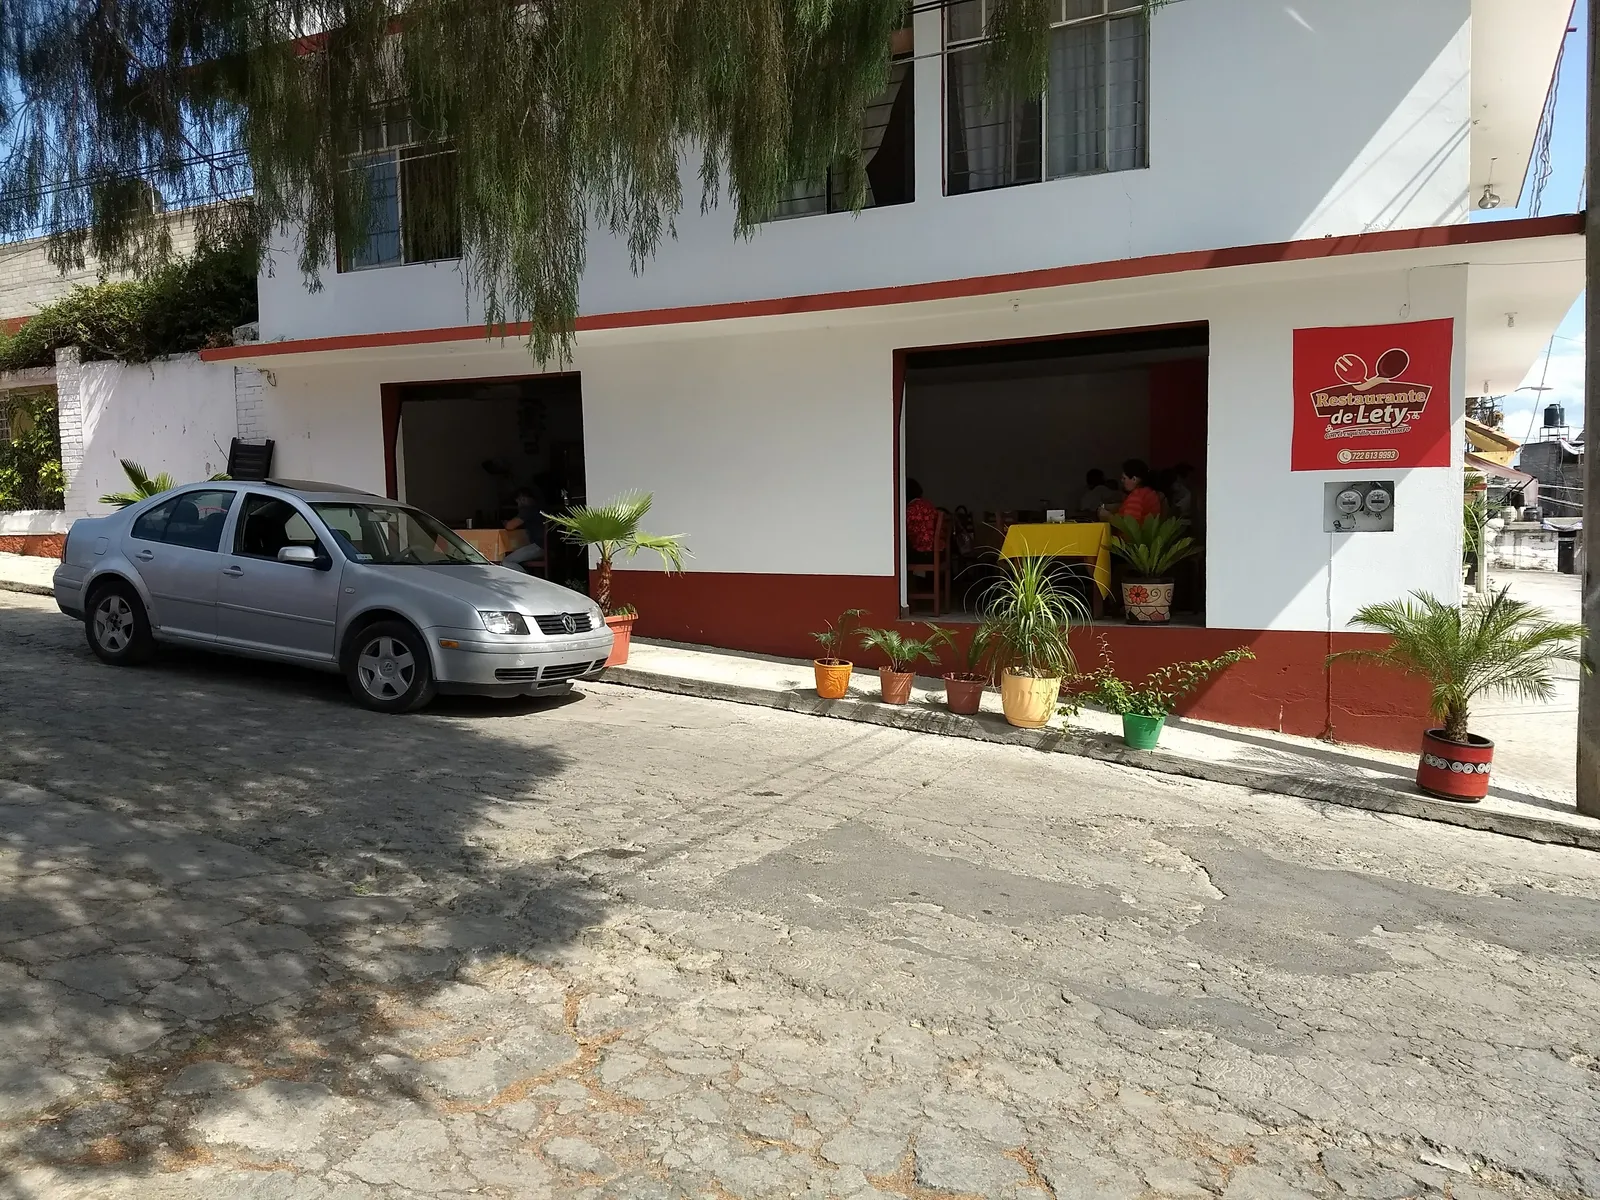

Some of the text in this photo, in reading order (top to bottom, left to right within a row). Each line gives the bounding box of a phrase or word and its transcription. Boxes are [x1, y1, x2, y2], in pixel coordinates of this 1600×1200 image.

[1316, 390, 1426, 407] Restaurante
[1331, 405, 1408, 427] de Lety
[1352, 452, 1364, 460] 722
[1365, 451, 1378, 460] 613
